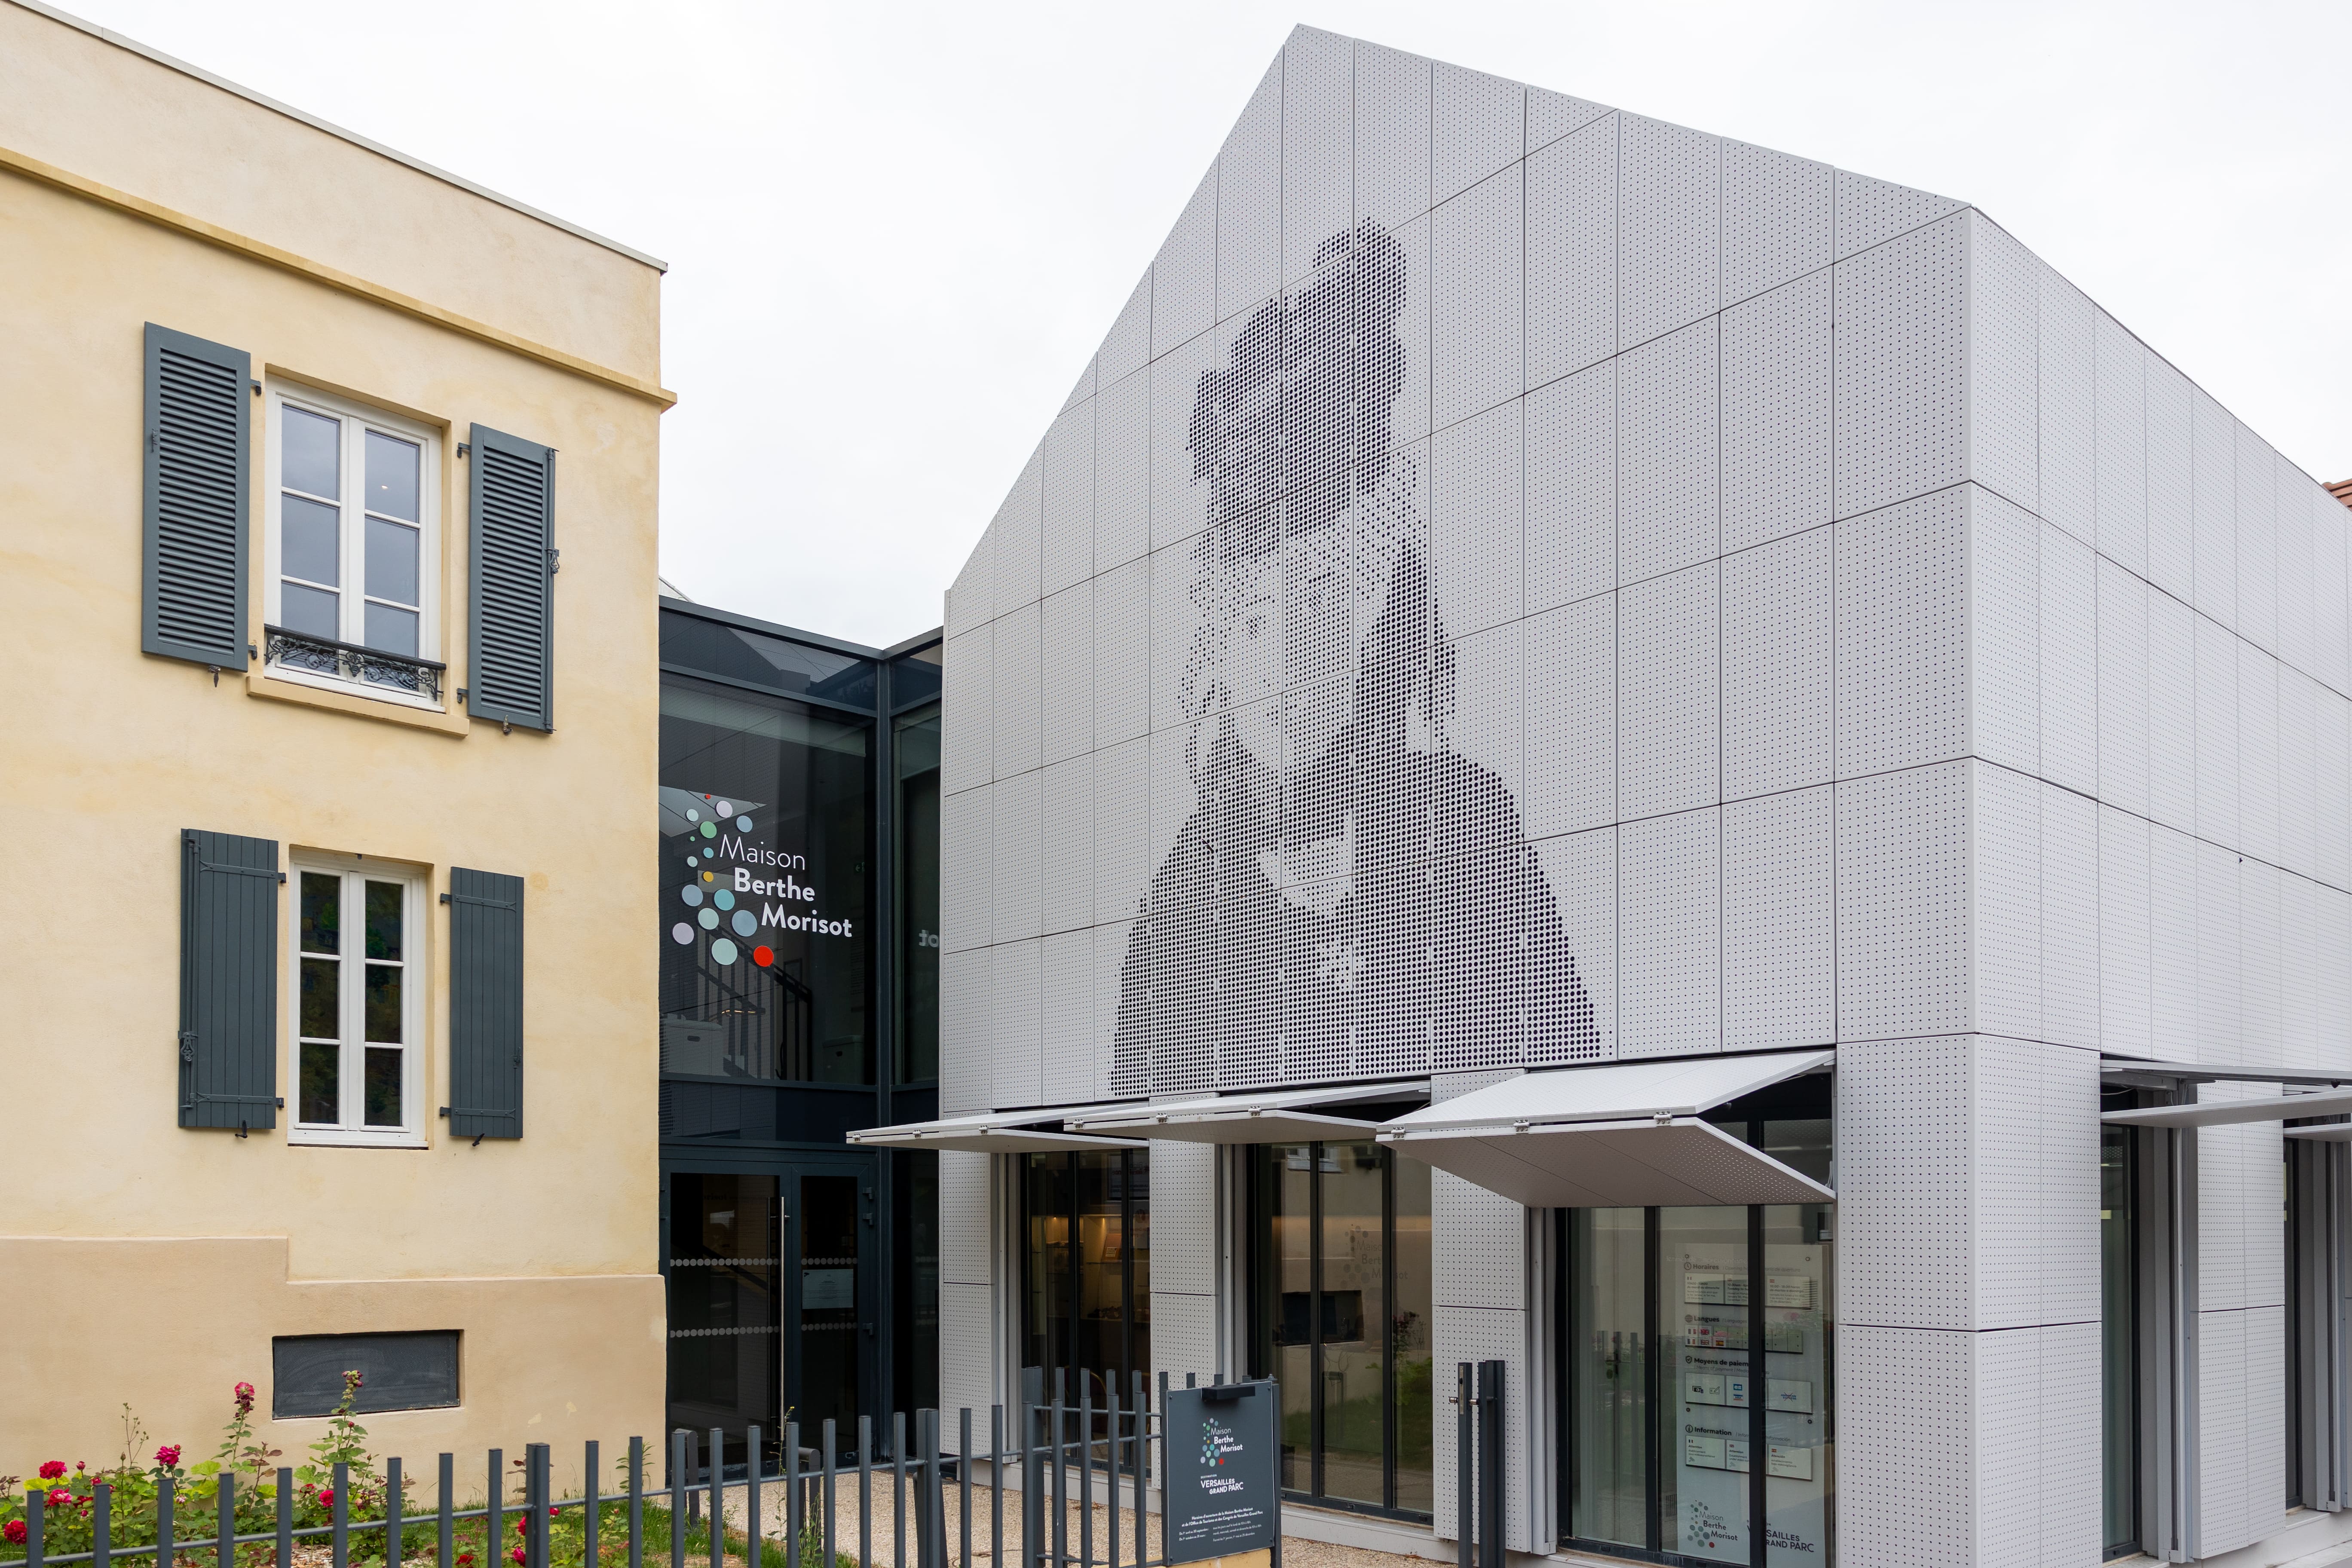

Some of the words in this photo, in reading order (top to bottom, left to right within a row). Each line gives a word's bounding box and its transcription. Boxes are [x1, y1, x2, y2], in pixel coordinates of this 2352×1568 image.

[720, 834, 805, 870] Maison
[734, 867, 815, 902] Berthe
[761, 902, 852, 937] Morisot
[1357, 1240, 1382, 1251] Maiso
[1362, 1254, 1381, 1264] Bert
[1210, 1427, 1231, 1436] Maison
[1694, 1427, 1732, 1436] Information
[1214, 1435, 1234, 1445] Berthe
[1220, 1444, 1243, 1453] Morisot
[1200, 1478, 1235, 1488] VERSAILLES
[1209, 1485, 1228, 1495] GRAND
[1228, 1482, 1244, 1492] PARC
[1699, 1511, 1724, 1521] Maison
[1703, 1520, 1727, 1531] Berthe
[1711, 1530, 1738, 1541] Morisot
[1766, 1539, 1787, 1548] RAND
[1790, 1542, 1814, 1553] PARC
